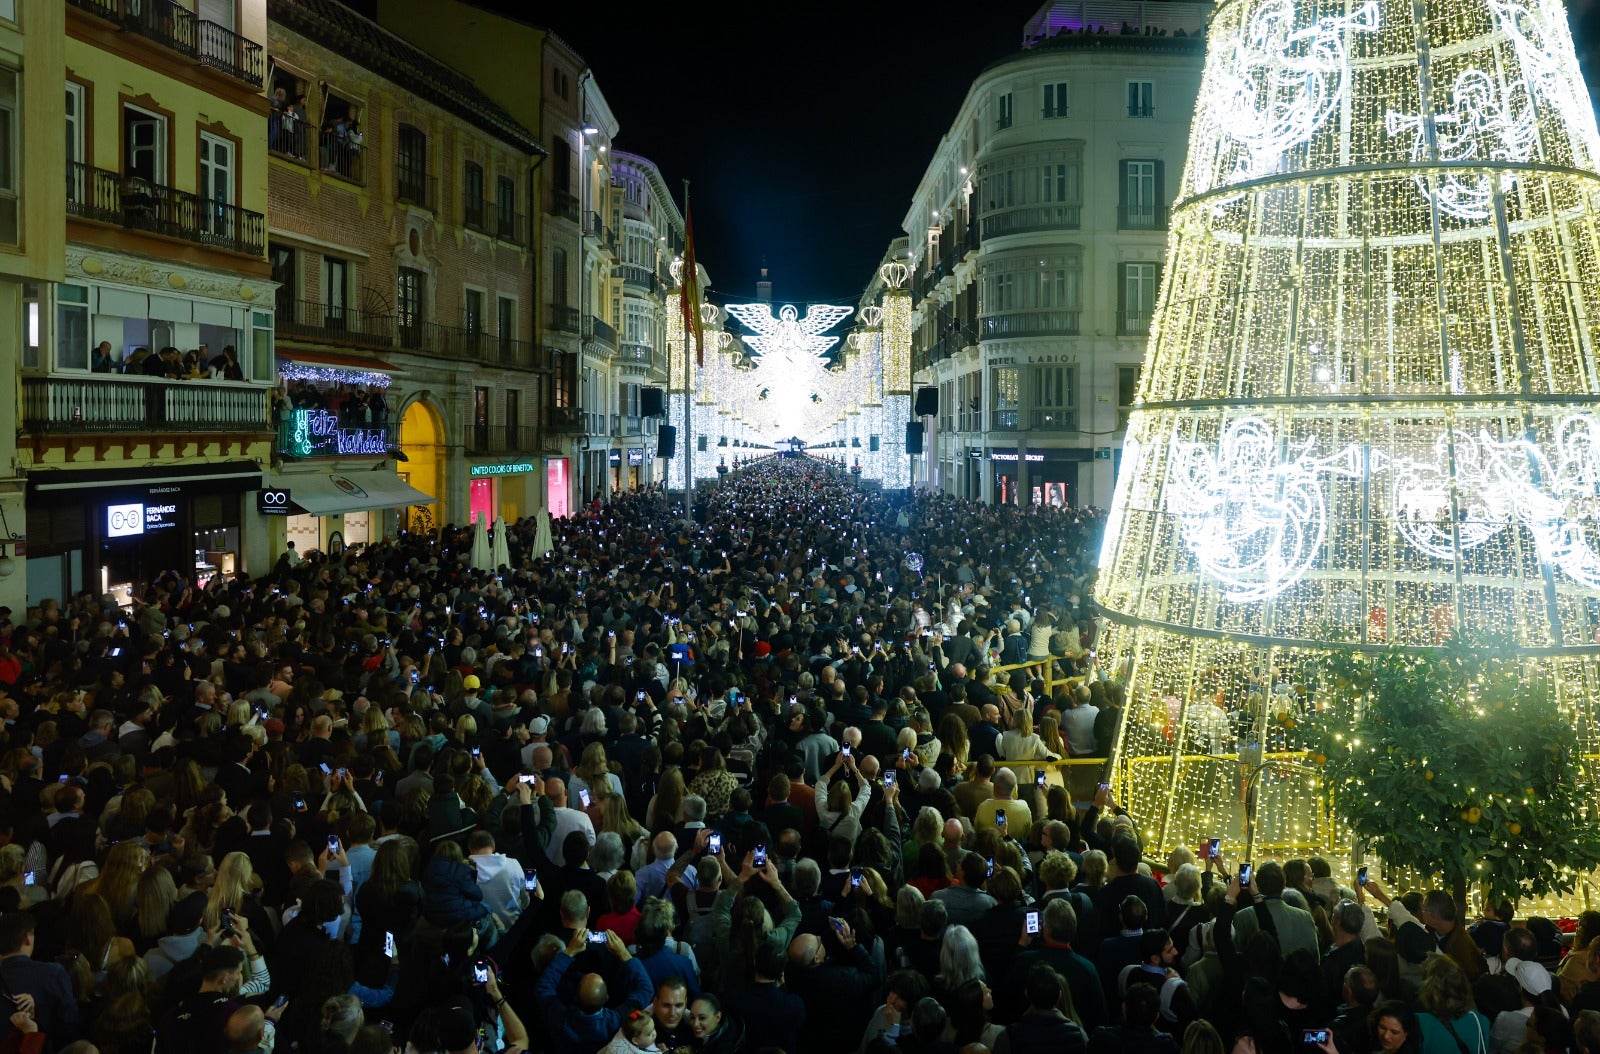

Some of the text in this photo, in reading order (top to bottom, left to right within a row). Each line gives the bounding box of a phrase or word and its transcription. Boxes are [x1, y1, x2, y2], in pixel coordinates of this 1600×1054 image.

[306, 409, 338, 437] Feliz
[337, 428, 386, 454] Navidad
[471, 463, 534, 475] UNITED COLORS OF BENETTON
[146, 505, 176, 515] FERNÁNDEZ
[146, 514, 162, 523] BACA
